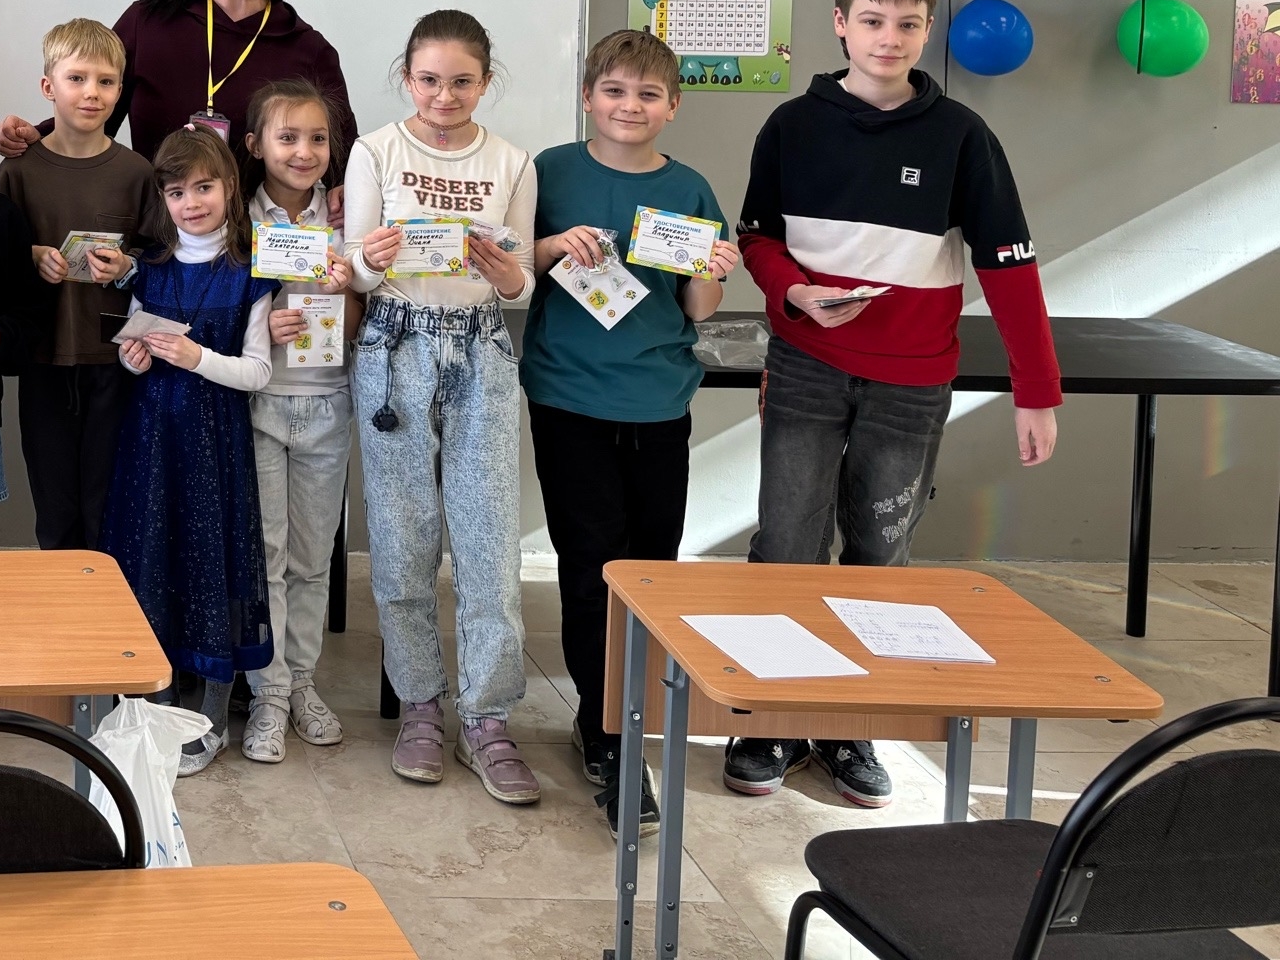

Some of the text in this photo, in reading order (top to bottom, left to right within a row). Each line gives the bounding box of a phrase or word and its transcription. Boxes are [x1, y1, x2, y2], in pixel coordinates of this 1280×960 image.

[402, 171, 494, 196] DESERT
[413, 190, 484, 212] VIBES
[653, 220, 702, 233] УДОСТОВЕРЕНИЕ
[997, 240, 1035, 262] FILA
